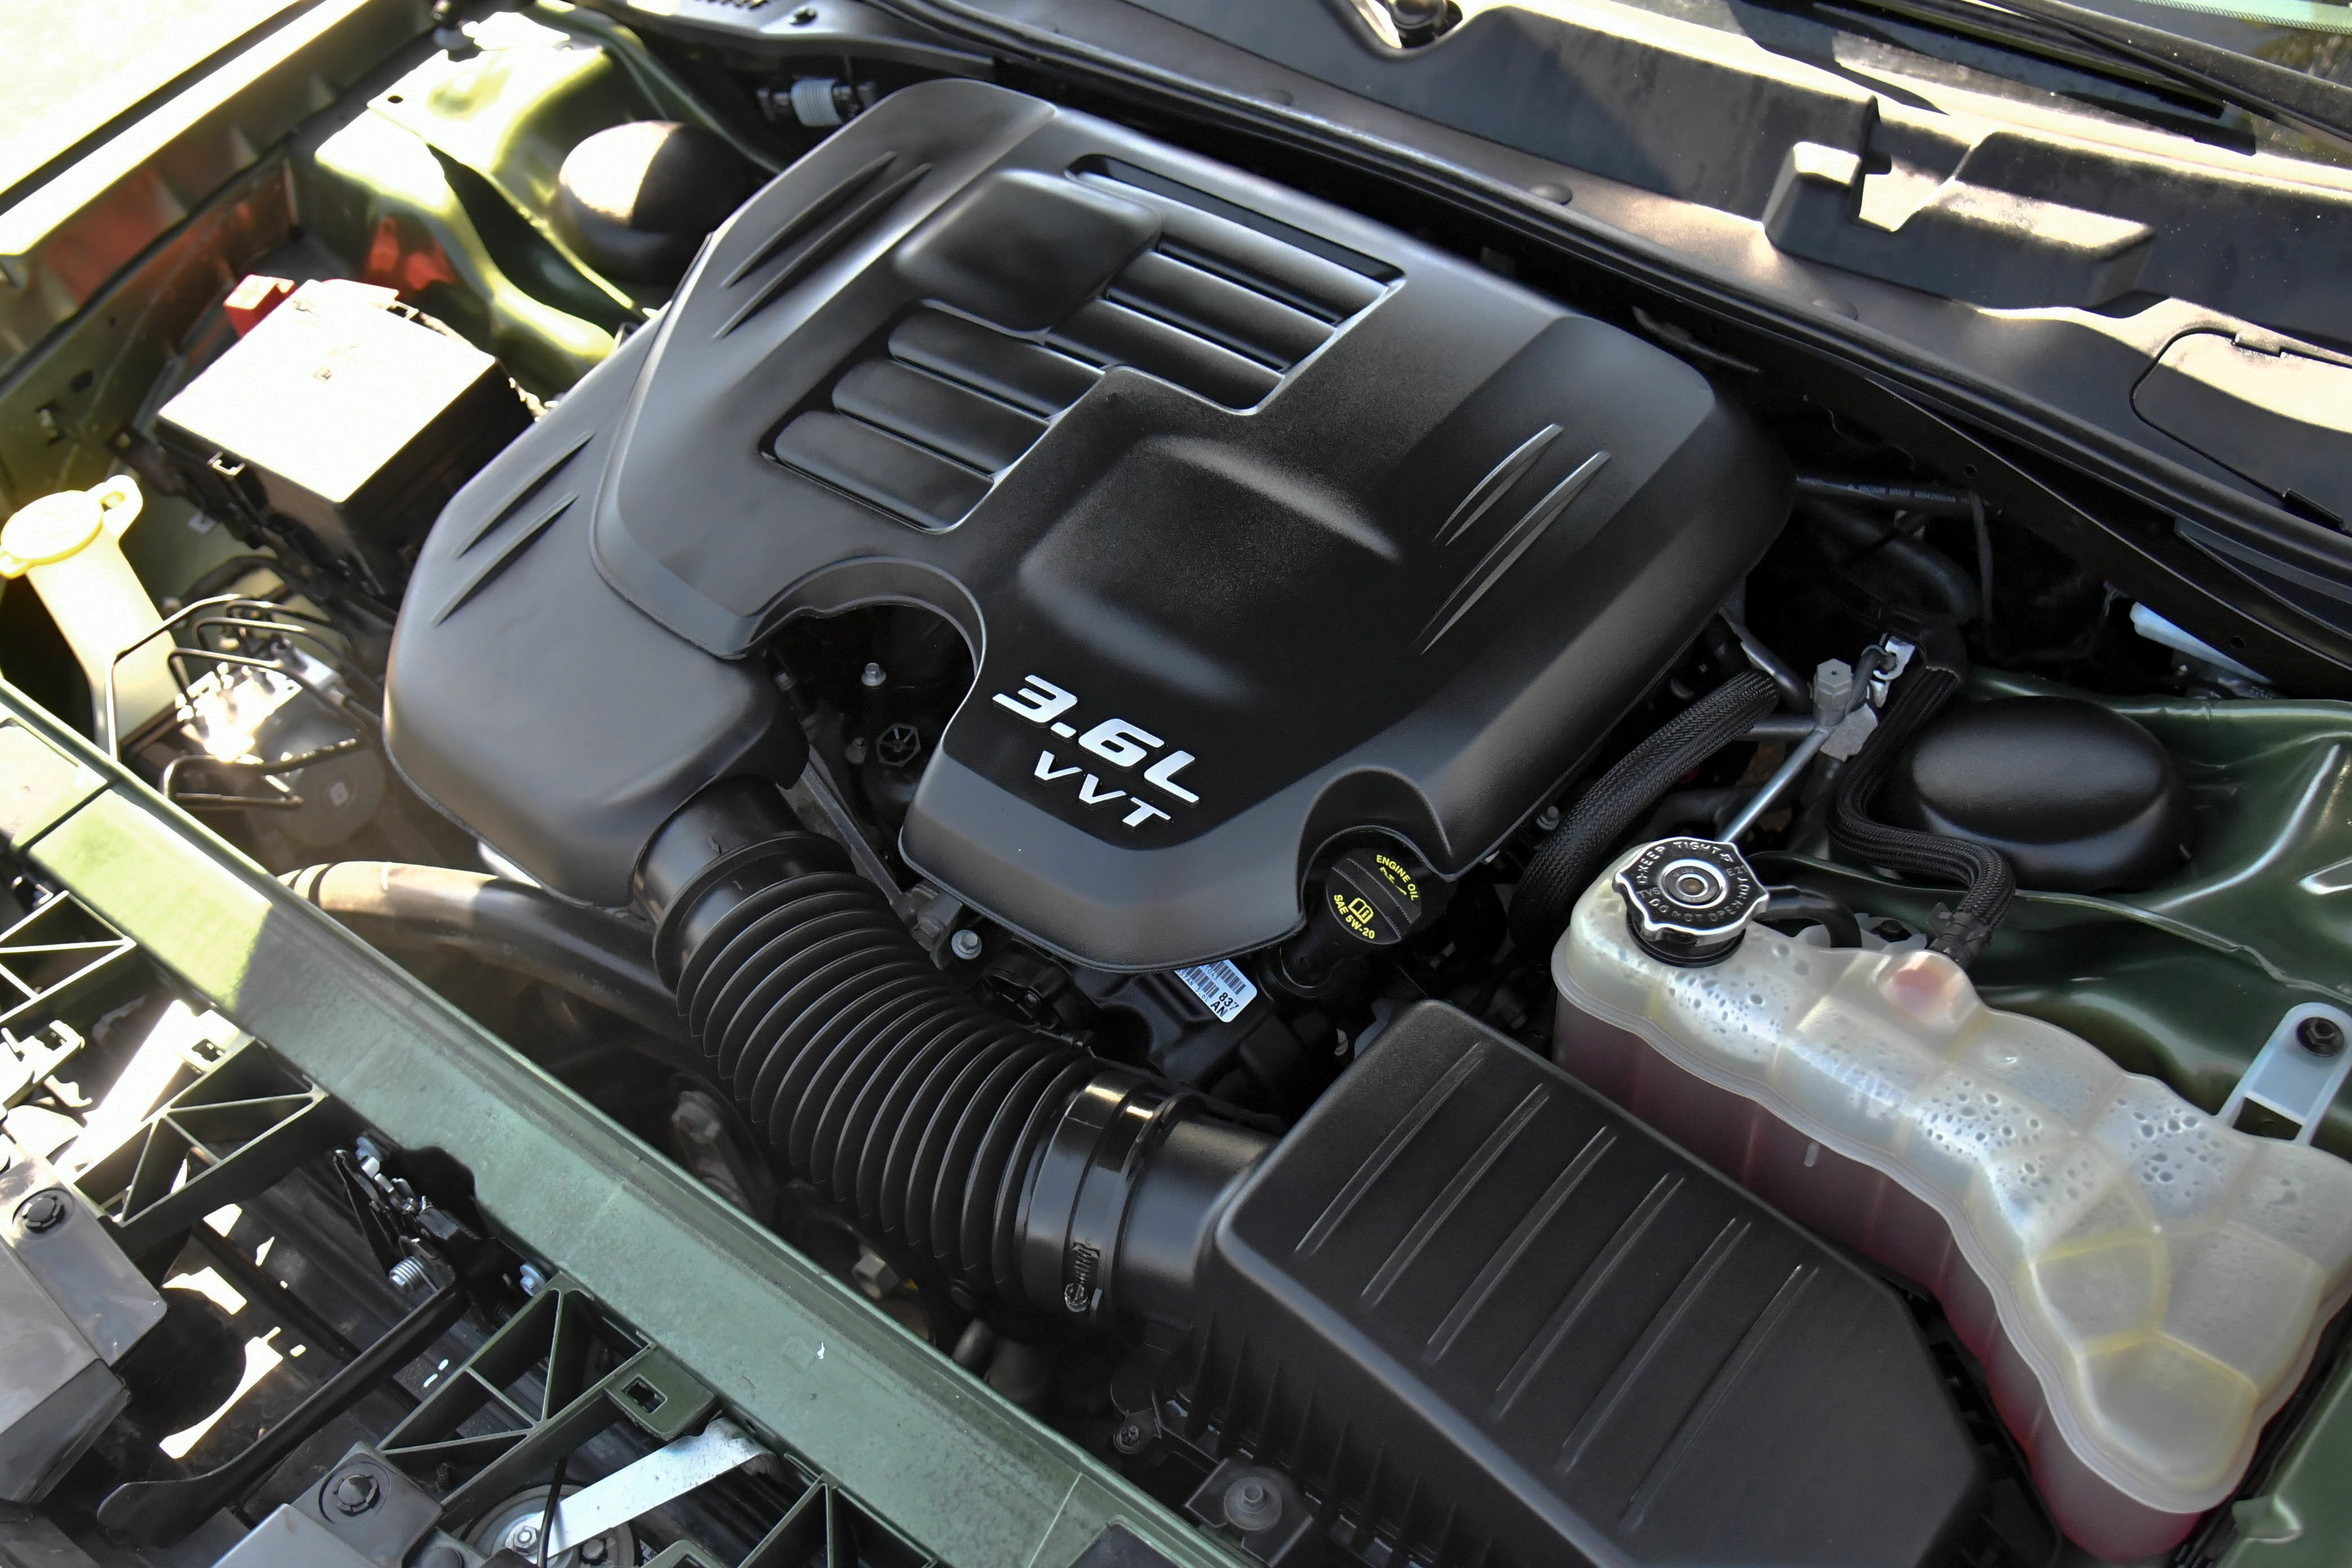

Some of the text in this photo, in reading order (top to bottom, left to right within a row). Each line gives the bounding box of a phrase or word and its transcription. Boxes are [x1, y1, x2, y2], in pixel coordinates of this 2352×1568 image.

[992, 674, 1200, 805] 3.6L
[1034, 750, 1171, 828] VVT
[1637, 845, 1665, 873] KEEP
[1672, 841, 1722, 854] TIGHT
[1376, 854, 1419, 901] ENGINE OIL
[1636, 887, 1661, 899] TVS
[1649, 897, 1670, 913] DO
[1333, 893, 1375, 939] SAE 5W-20
[1195, 986, 1209, 1003] 3.6L
[1218, 991, 1240, 1011] 837
[1210, 1000, 1230, 1018] AN
